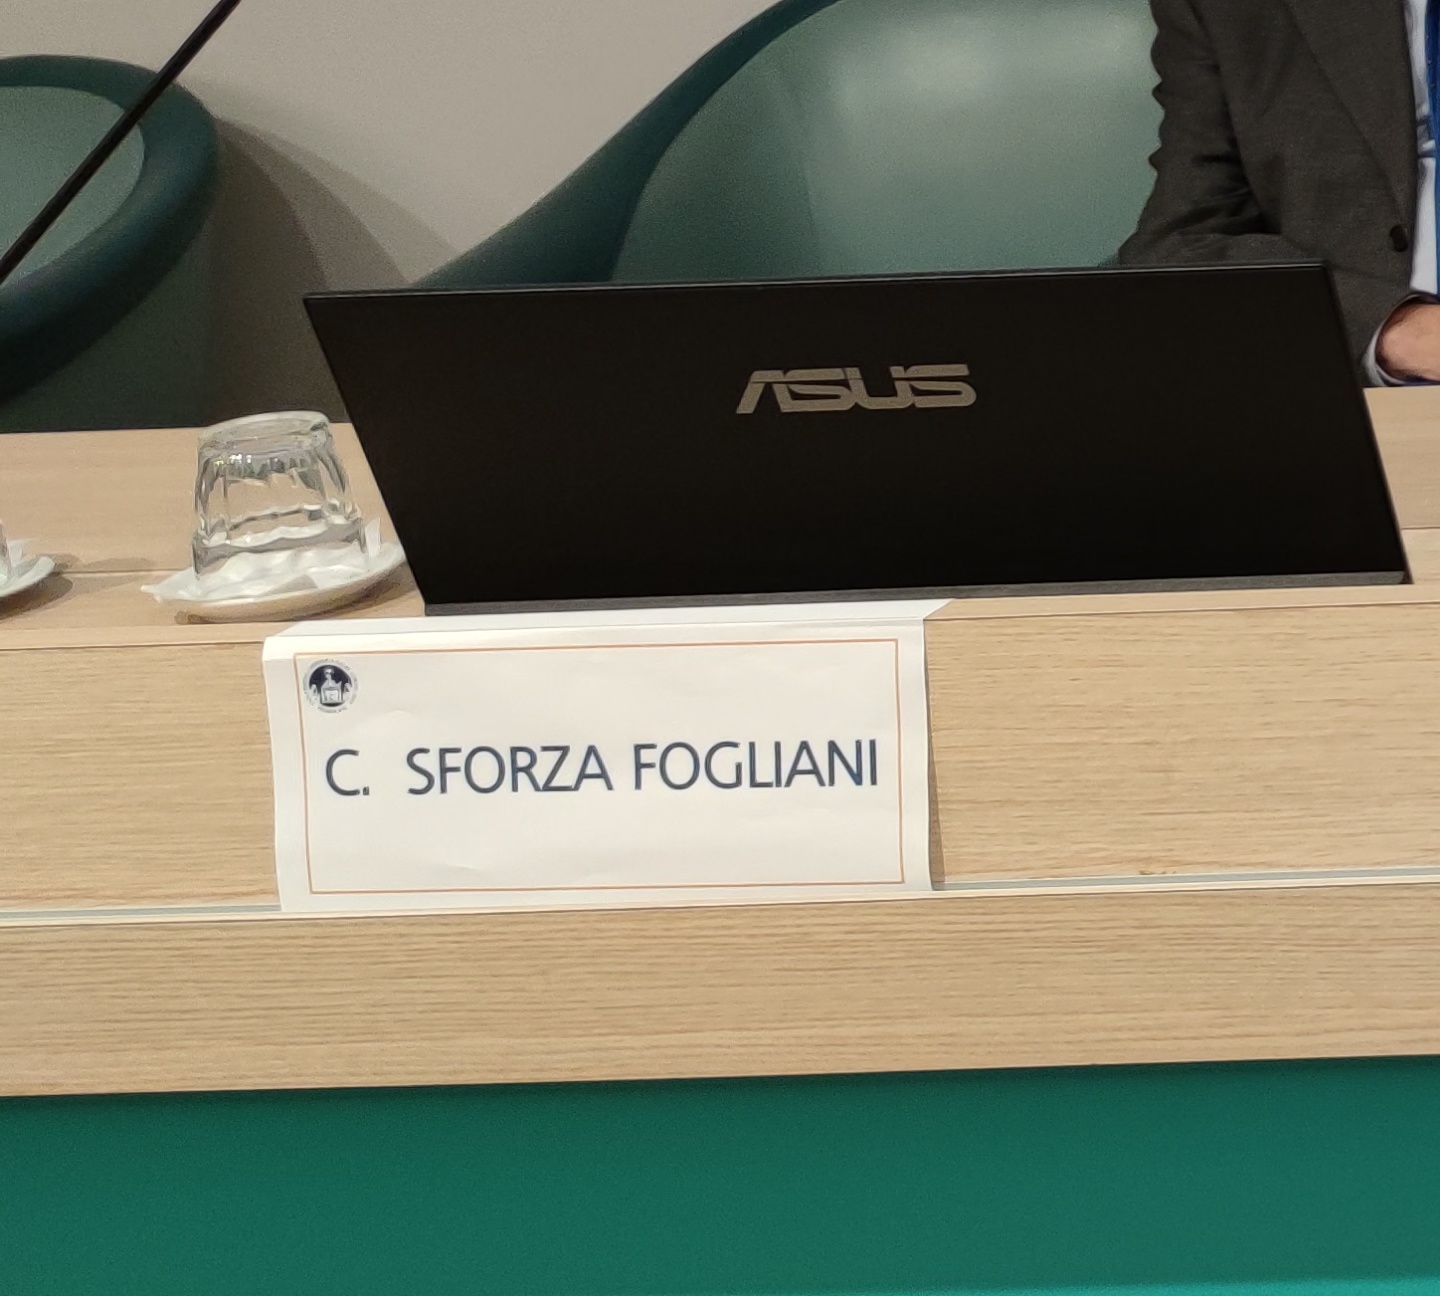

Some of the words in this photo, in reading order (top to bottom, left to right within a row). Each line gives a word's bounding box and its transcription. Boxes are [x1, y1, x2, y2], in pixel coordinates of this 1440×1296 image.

[736, 364, 977, 414] ASUS
[324, 747, 370, 796] C.
[407, 744, 614, 794] SFORZA
[632, 738, 878, 791] FOGLIANI
